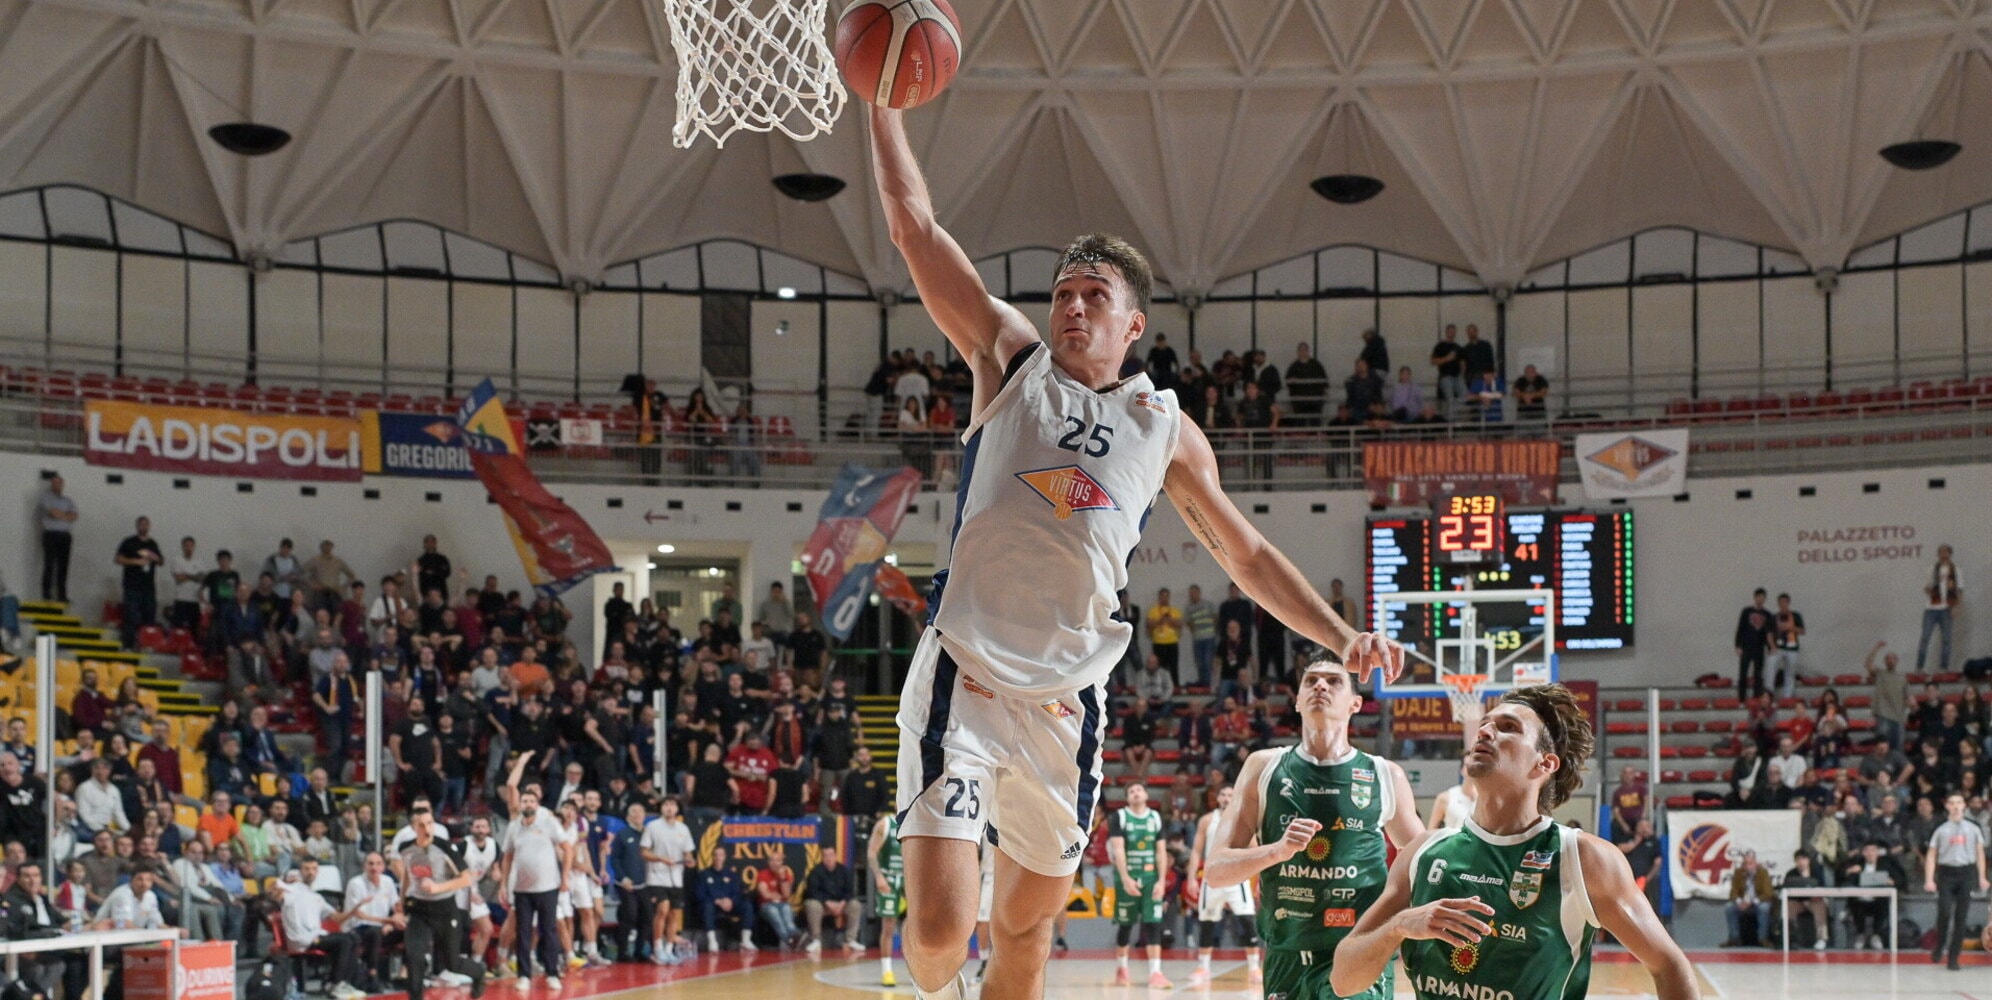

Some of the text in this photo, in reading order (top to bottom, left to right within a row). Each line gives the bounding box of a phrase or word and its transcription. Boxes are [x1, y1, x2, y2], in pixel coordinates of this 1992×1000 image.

[88, 411, 361, 469] LADISPOLI
[1057, 415, 1114, 458] 25
[1050, 474, 1092, 502] VIRTUS
[1451, 495, 1496, 515] 3:53
[1439, 515, 1494, 551] 23
[1797, 525, 1916, 543] PALAZZETTO
[1514, 543, 1539, 562] 41
[1797, 544, 1923, 563] DELLO SPORT
[1393, 697, 1442, 718] DAJE
[1280, 778, 1293, 798] 2
[945, 777, 981, 820] 25
[723, 824, 816, 838] CHRISTIAN
[1346, 817, 1364, 830] SIA
[1279, 863, 1358, 880] ARMANDO
[1427, 858, 1448, 886] 6
[1500, 923, 1526, 940] SIA
